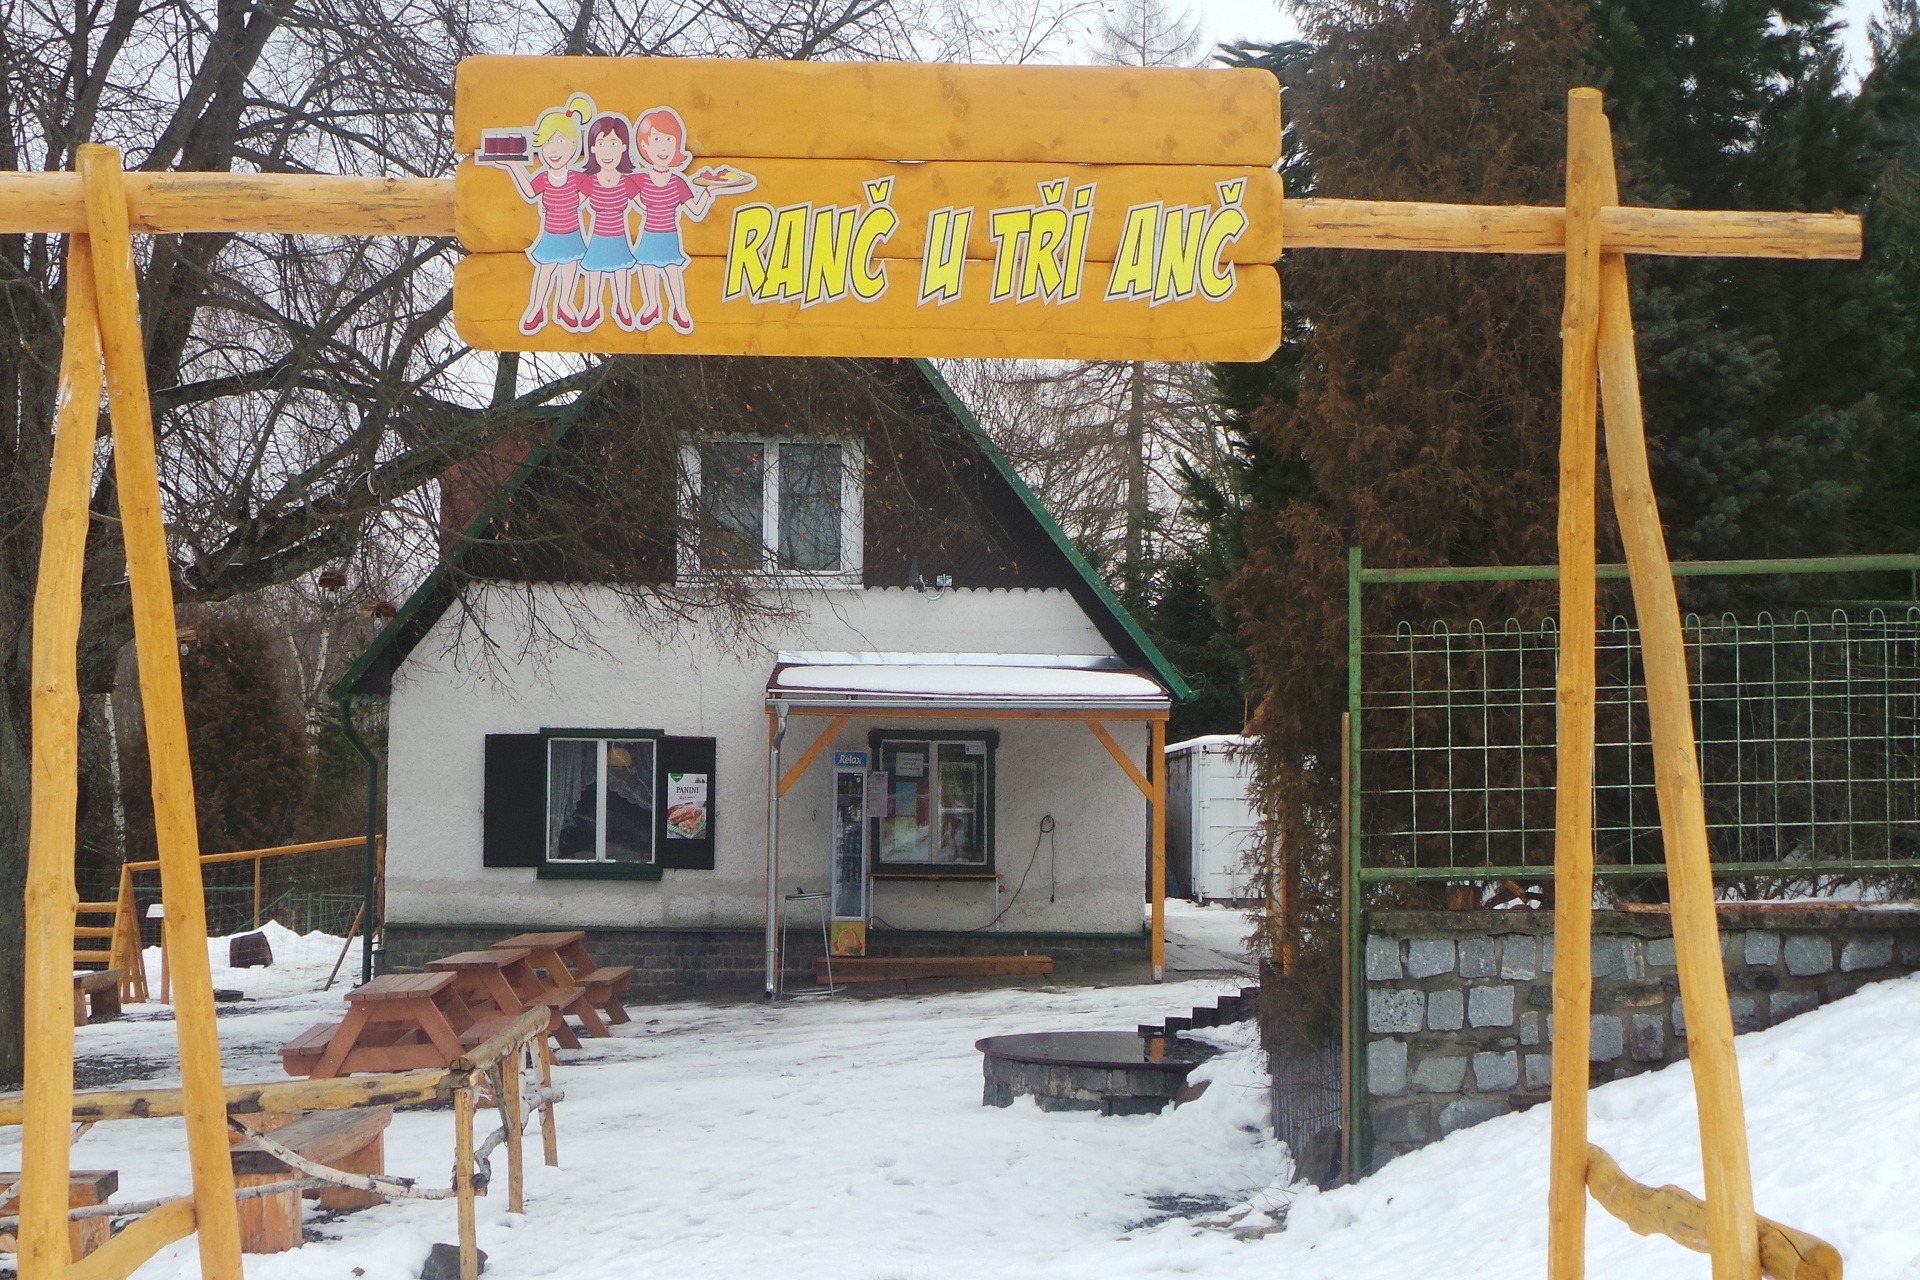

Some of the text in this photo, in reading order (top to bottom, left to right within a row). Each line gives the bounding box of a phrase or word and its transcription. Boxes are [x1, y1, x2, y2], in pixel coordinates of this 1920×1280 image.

[724, 179, 898, 308] RANČ
[919, 208, 973, 305] U
[1105, 178, 1248, 306] ANČ
[839, 754, 862, 765] Relax
[676, 786, 699, 794] PANINI
